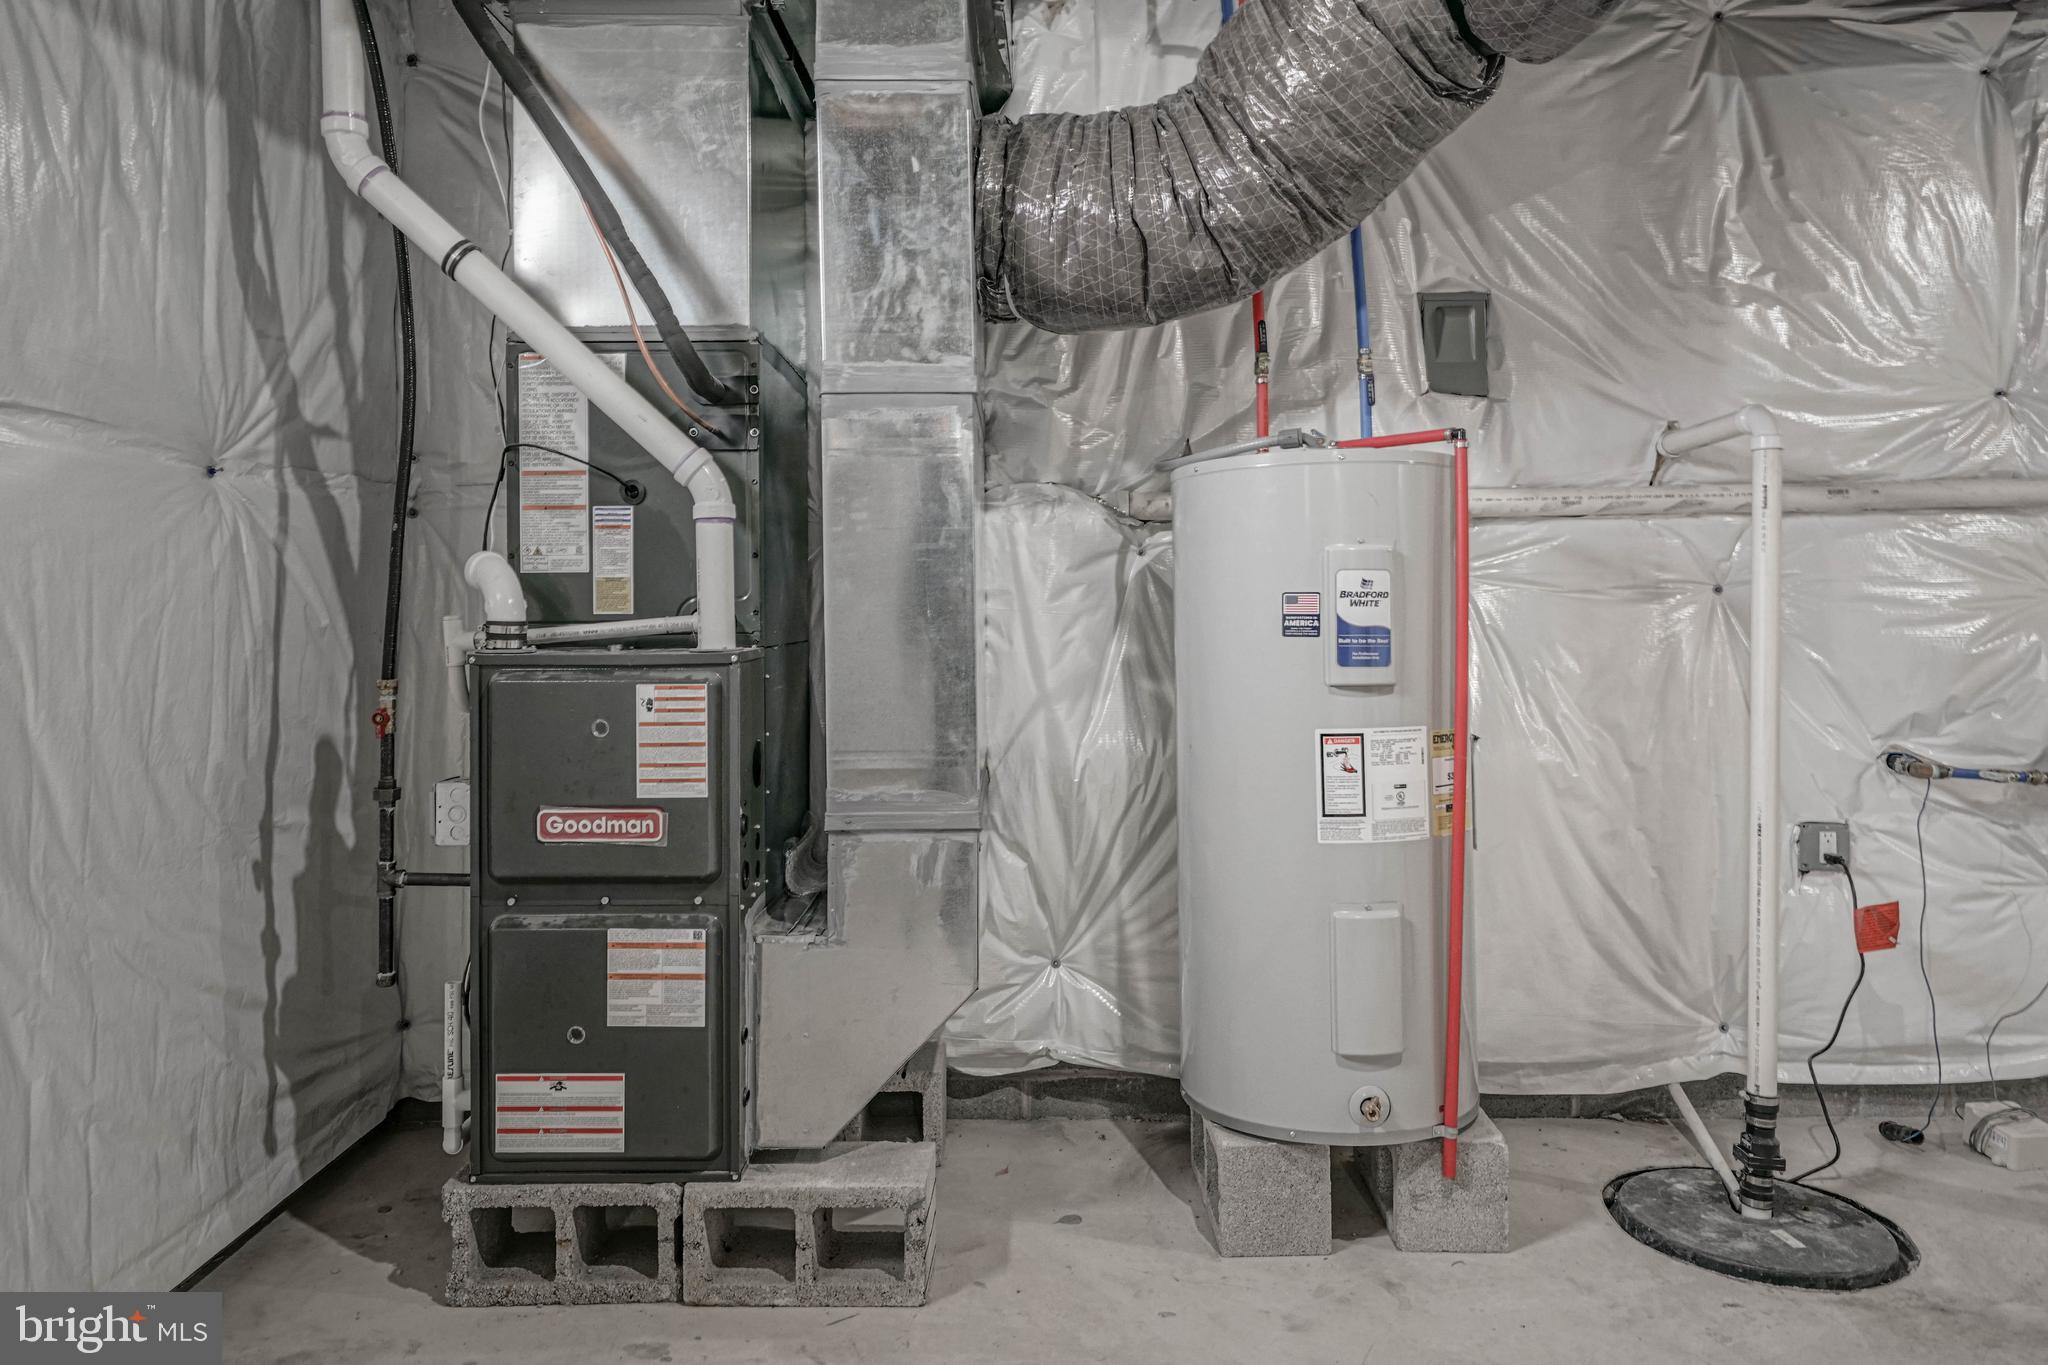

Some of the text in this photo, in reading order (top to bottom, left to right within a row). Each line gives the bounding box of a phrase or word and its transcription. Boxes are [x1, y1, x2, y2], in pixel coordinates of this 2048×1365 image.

[1339, 590, 1389, 599] BRADFORD
[1349, 599, 1380, 607] WHITE
[546, 815, 655, 835] Goodman
